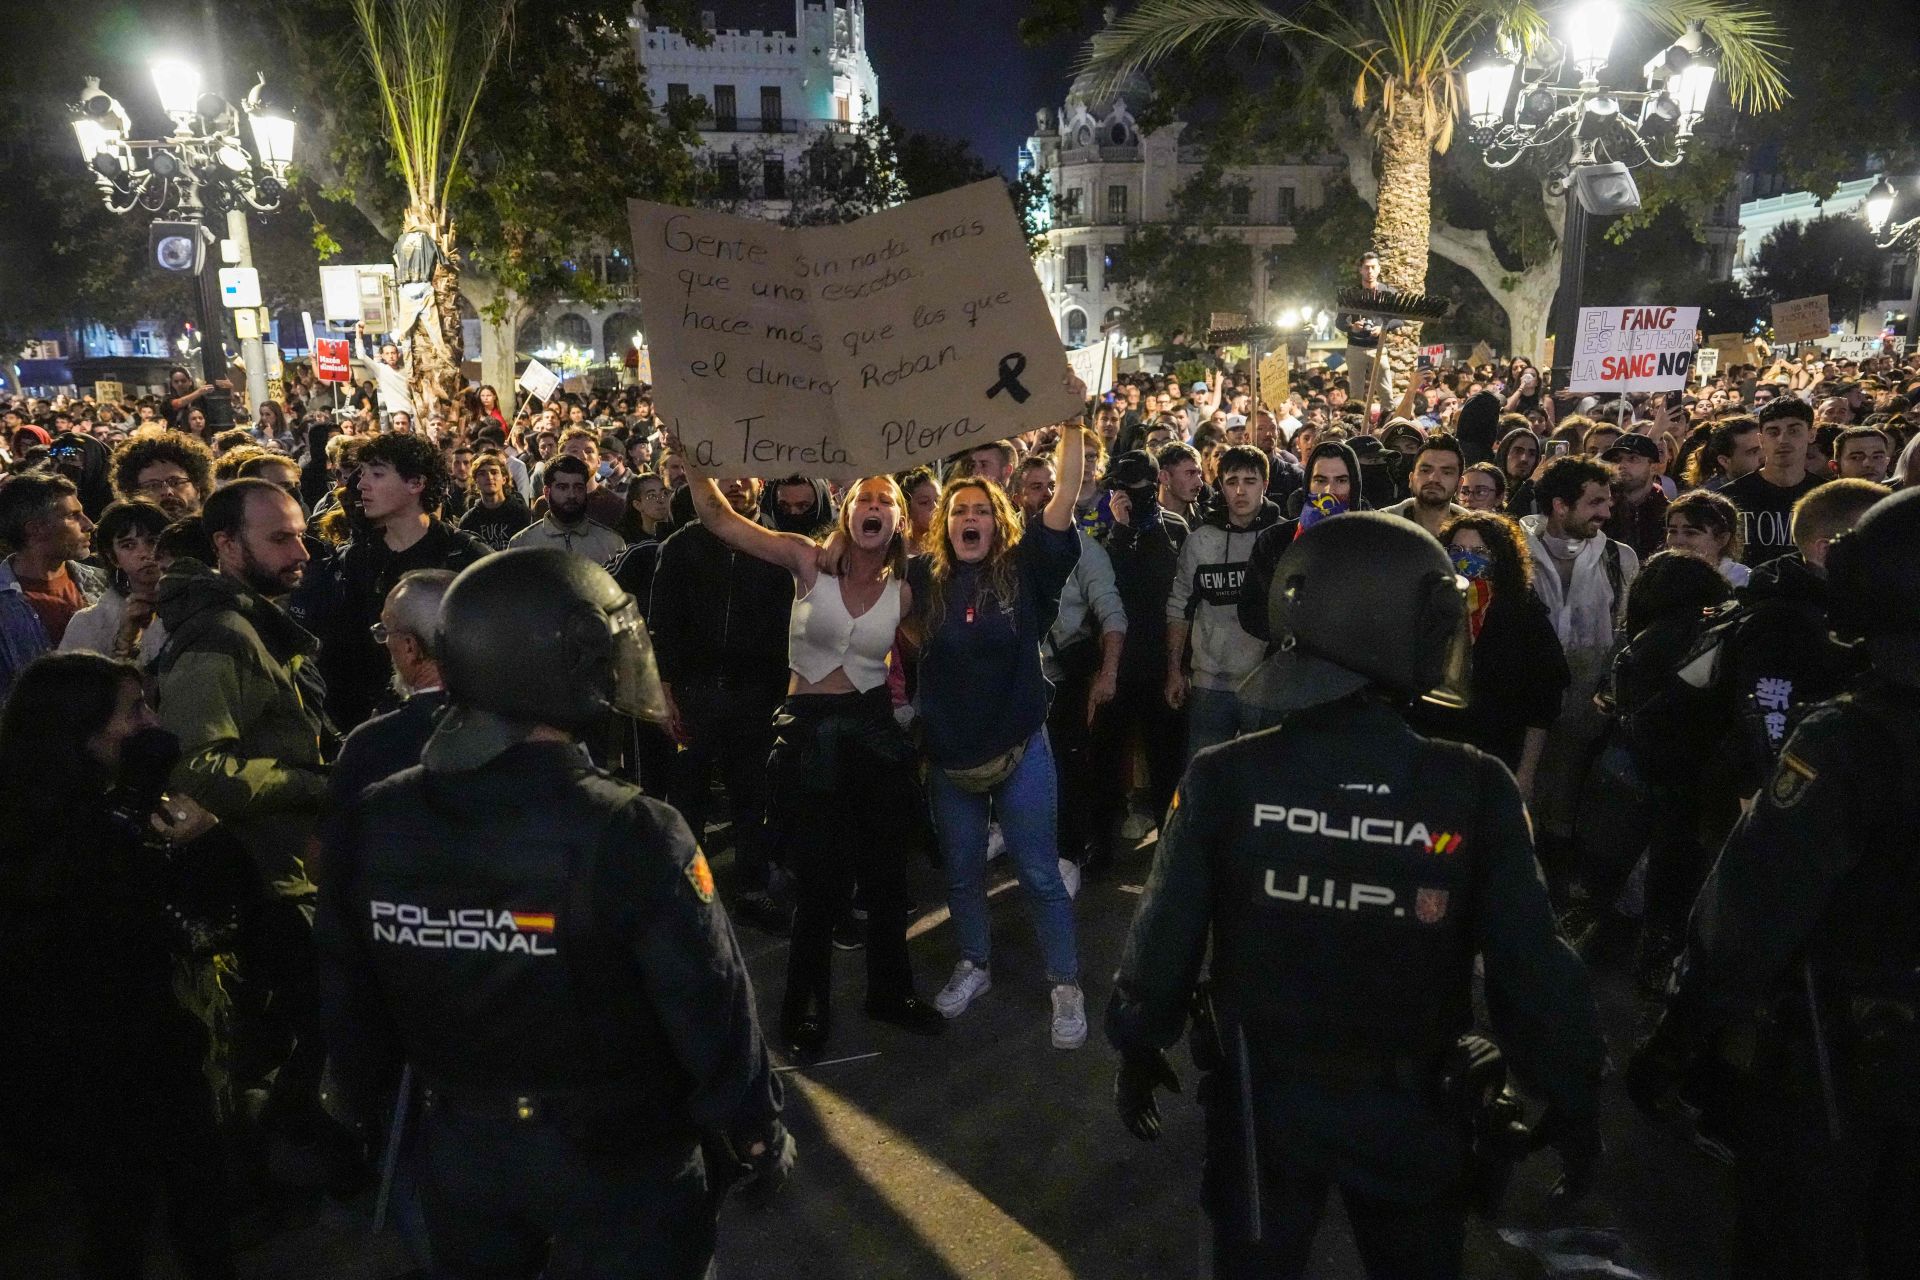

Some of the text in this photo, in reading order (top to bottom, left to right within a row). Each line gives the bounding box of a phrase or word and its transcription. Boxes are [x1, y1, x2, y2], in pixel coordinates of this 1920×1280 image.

[664, 215, 768, 264] Gente
[852, 238, 910, 271] nada
[930, 217, 985, 246] más
[678, 268, 730, 298] que
[822, 267, 918, 301] escoba
[682, 291, 1012, 356] hace más que los que
[1584, 307, 1678, 332] EL FANG
[1583, 328, 1696, 354] ES NETEJA
[691, 345, 958, 395] el dinero Roban
[1572, 351, 1691, 381] LA SANG NO
[735, 415, 858, 468] Terreta
[881, 416, 986, 460] Plora
[480, 523, 509, 540] FUCK
[1253, 803, 1434, 848] POLICIA
[1264, 869, 1405, 917] U.I.P.
[370, 900, 518, 931] POLICIA
[373, 922, 557, 955] NACIONAL
